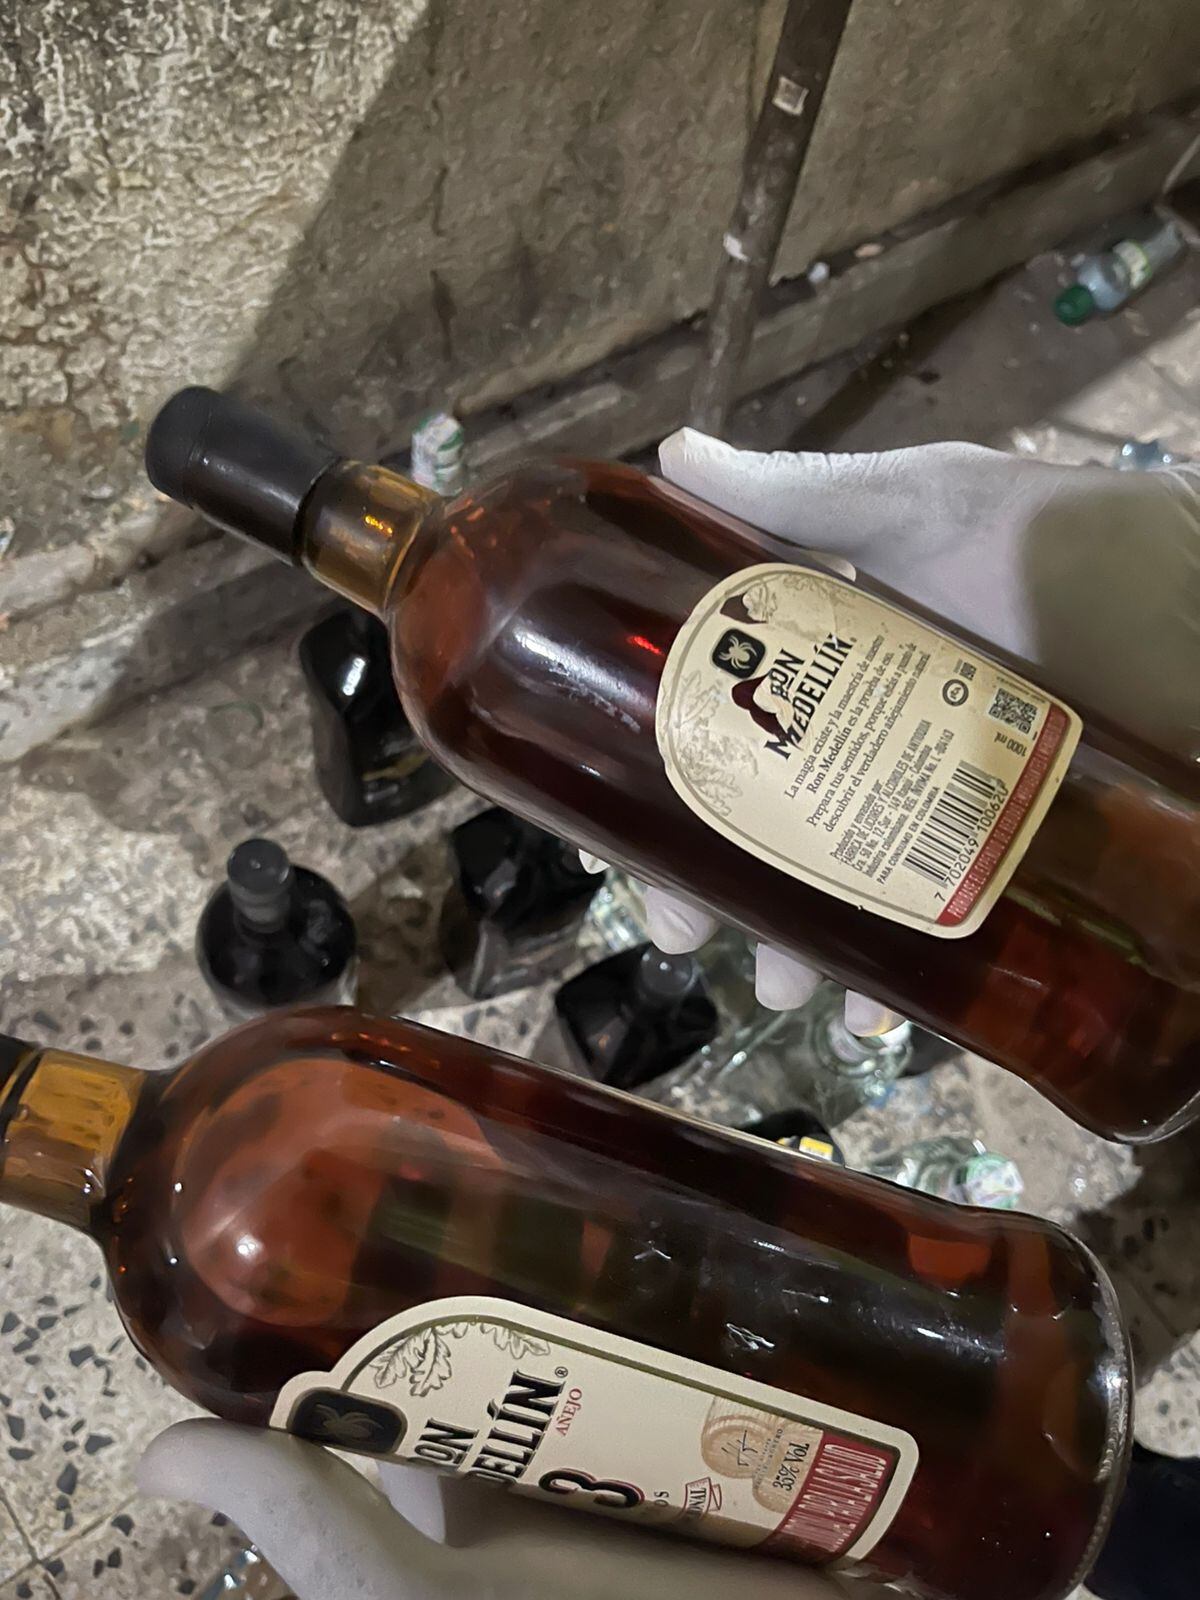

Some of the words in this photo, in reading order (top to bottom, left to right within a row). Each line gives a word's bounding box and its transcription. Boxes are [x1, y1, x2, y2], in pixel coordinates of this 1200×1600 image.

[769, 648, 805, 695] RON
[763, 632, 853, 760] MEDELLÍN
[834, 669, 865, 711] maestría
[855, 673, 883, 708] prueba
[827, 717, 841, 730] y
[828, 706, 843, 721] la
[846, 713, 859, 728] es
[849, 702, 864, 717] la
[863, 696, 890, 732] porque
[808, 723, 834, 756] existe
[817, 723, 852, 772] Medellín
[836, 725, 870, 774] sentidos,
[852, 725, 888, 778] verdadero
[791, 752, 820, 788] magia
[805, 768, 827, 794] Ron
[828, 769, 845, 788] tus
[847, 773, 862, 787] el
[783, 782, 800, 799] La
[805, 785, 838, 829] Prepara
[821, 783, 855, 833] descubrir
[870, 825, 884, 838] 12
[876, 863, 893, 885] PARA
[886, 829, 912, 867] CONSUMO
[905, 818, 919, 832] EN
[912, 782, 939, 821] COLOMBIA
[933, 891, 947, 904] 7
[944, 836, 980, 887] 702049
[553, 1385, 585, 1436] AÑEJO
[413, 1419, 479, 1466] ON
[537, 1464, 644, 1509] 3
[771, 1462, 800, 1491] 35%
